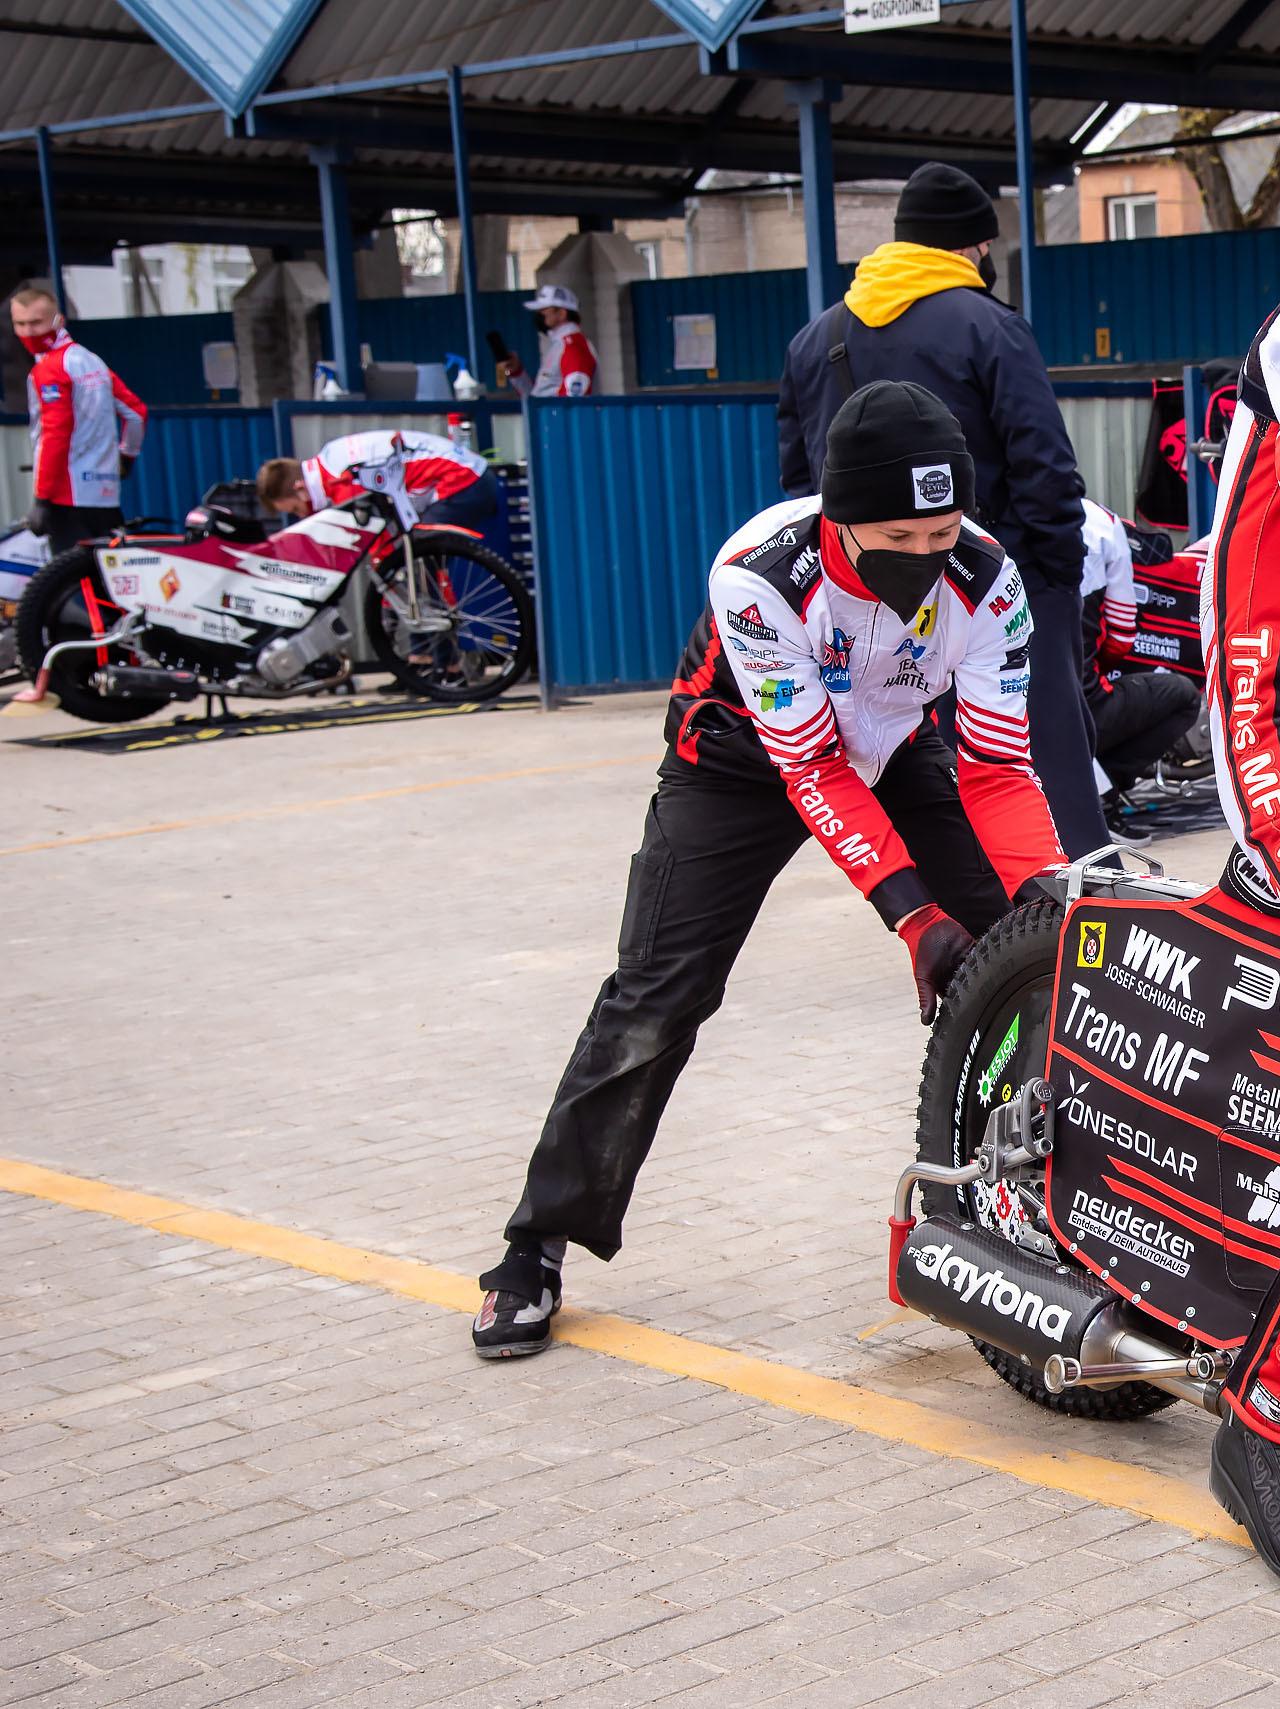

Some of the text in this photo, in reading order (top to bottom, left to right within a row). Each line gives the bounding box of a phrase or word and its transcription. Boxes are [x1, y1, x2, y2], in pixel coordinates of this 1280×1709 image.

[790, 545, 818, 586] WWK
[1133, 640, 1181, 661] SEEMANN
[1230, 628, 1270, 751] Trans
[795, 769, 880, 867] Trans MF
[1105, 962, 1206, 1029] JOSEF SCHWAIGER
[1122, 924, 1201, 1001] WWK
[991, 1031, 1017, 1074] ESJOT
[1064, 982, 1142, 1071] Trans
[1143, 1032, 1210, 1097] MF
[953, 1053, 972, 1124] PLATINUM
[1067, 1097, 1198, 1183] ONESOLAR
[906, 1245, 937, 1267] FREY
[1071, 1213, 1188, 1276] Entdecke DEIN AUTOHAUS
[1072, 1189, 1195, 1260] neudecker
[915, 1243, 1074, 1344] daytona
